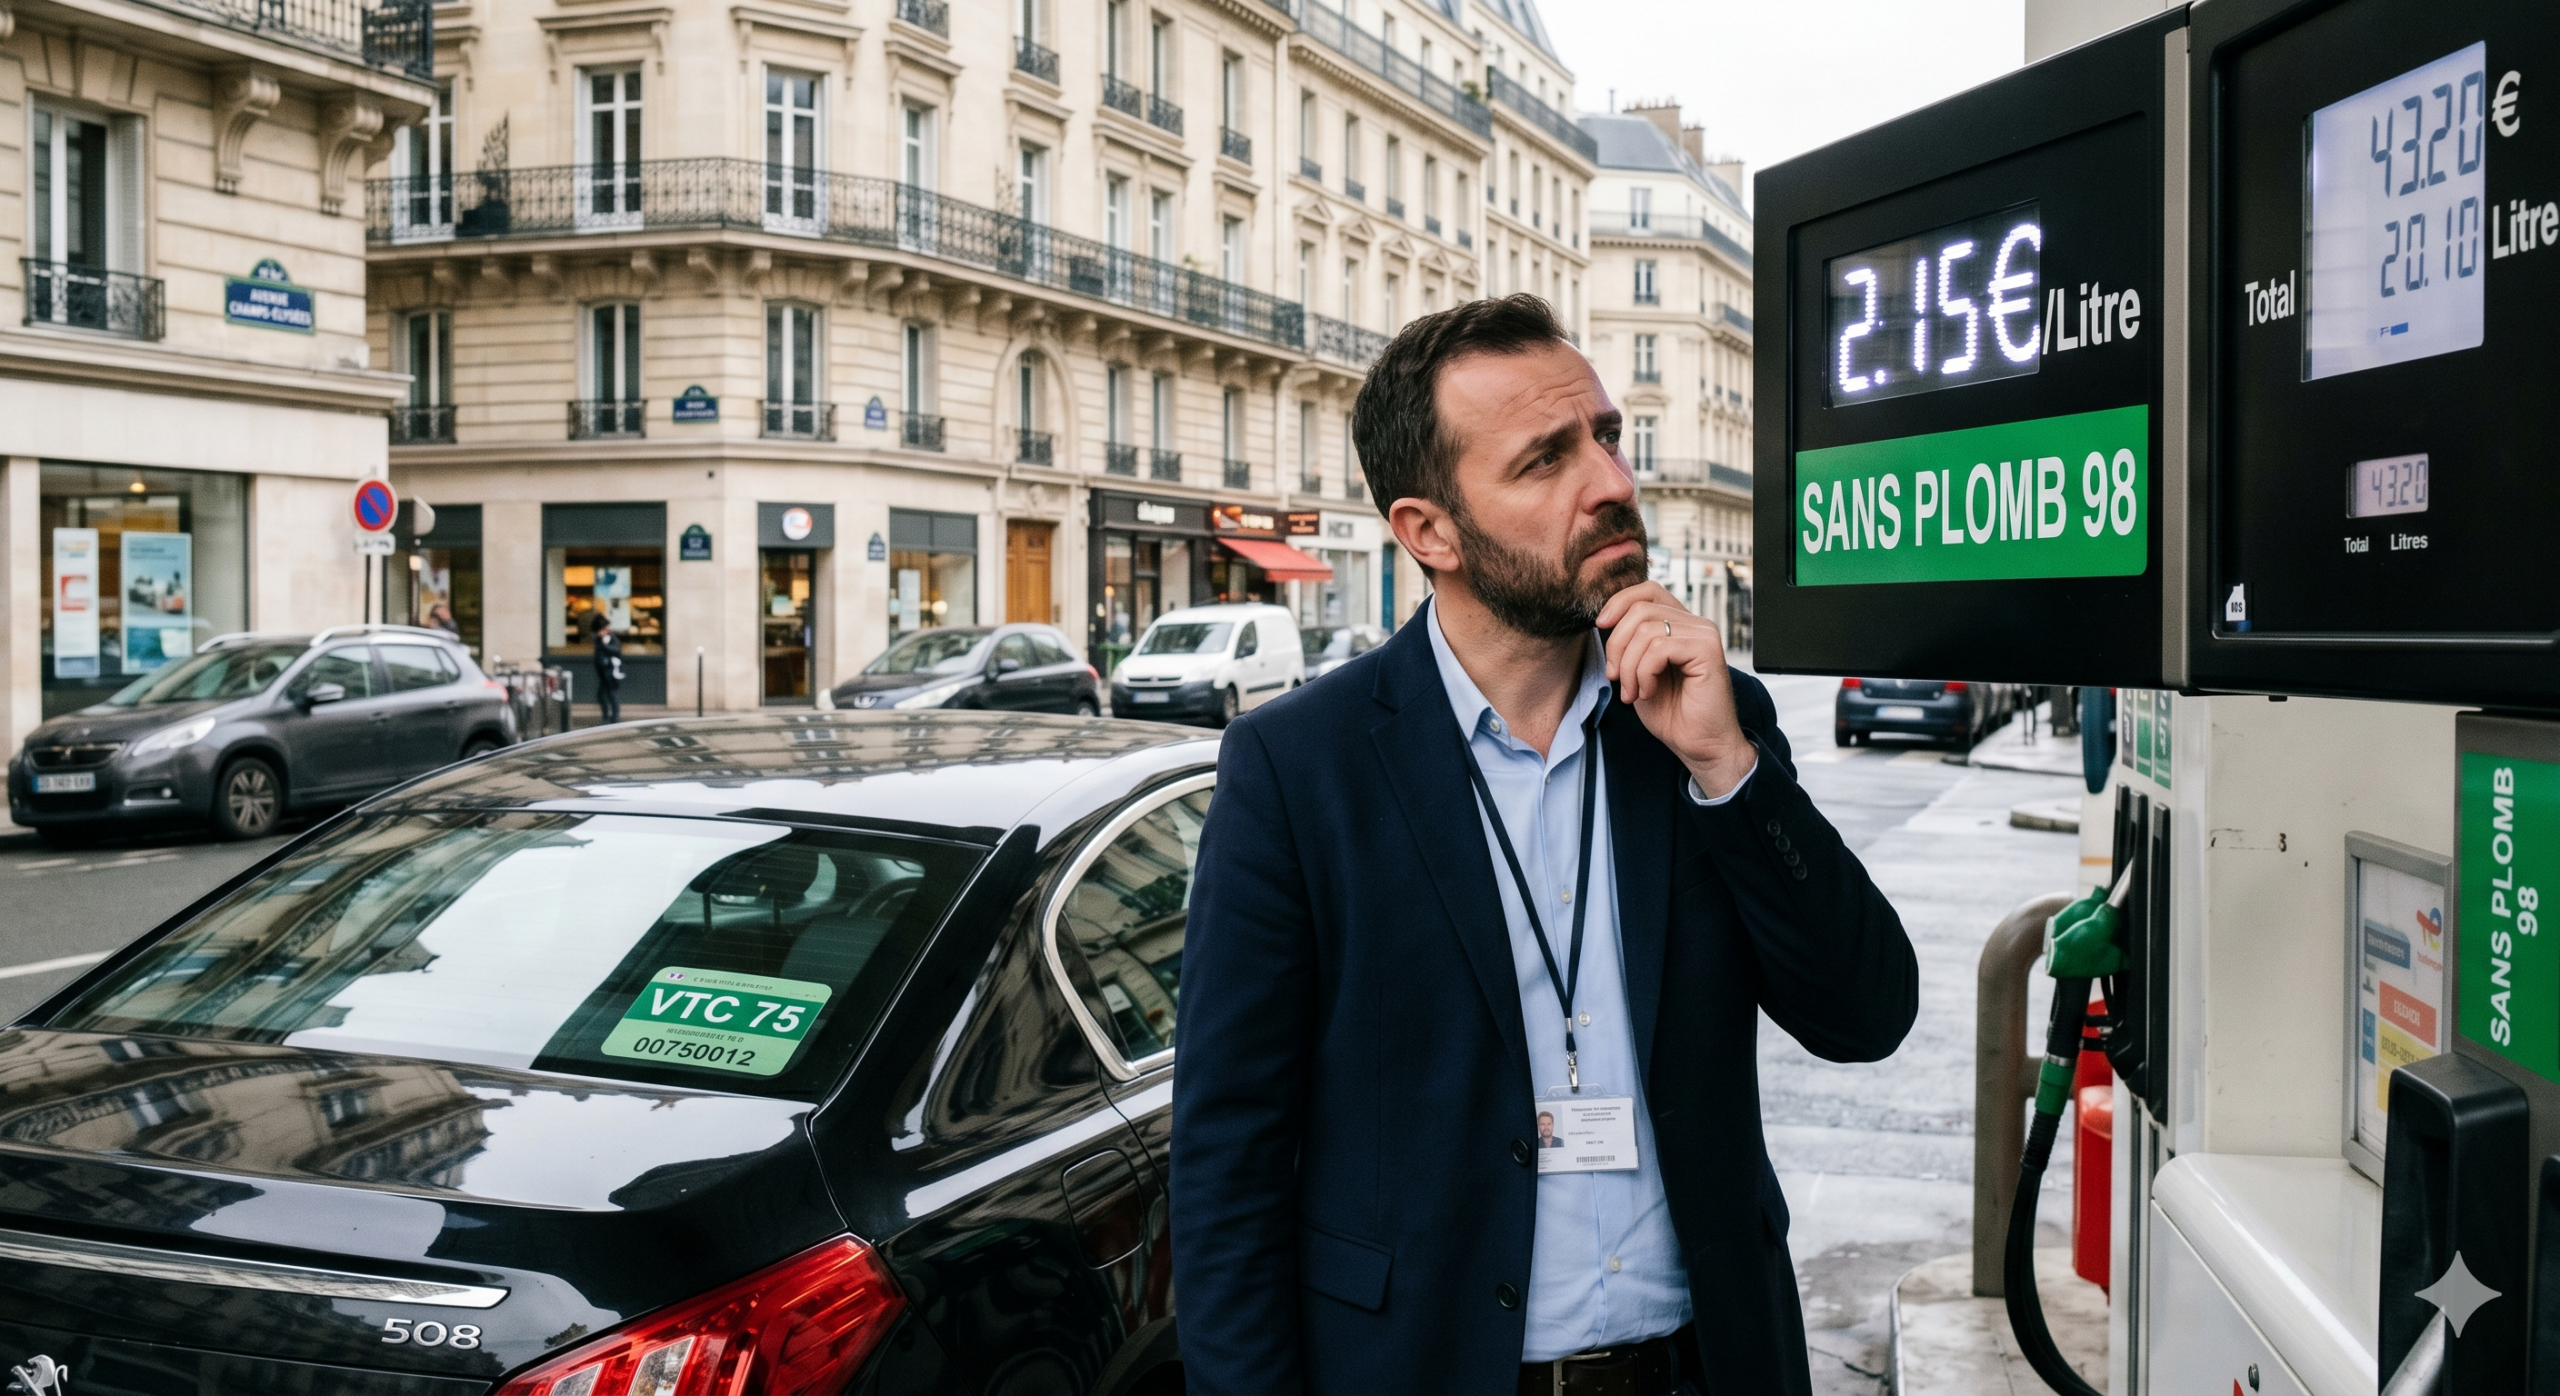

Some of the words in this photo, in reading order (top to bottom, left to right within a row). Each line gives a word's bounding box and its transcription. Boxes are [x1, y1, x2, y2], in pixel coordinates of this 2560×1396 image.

[2371, 70, 2484, 198] 43.20
[2491, 70, 2522, 137] €
[2380, 196, 2479, 298] 20.10
[2492, 199, 2559, 260] Litre
[2042, 281, 2141, 355] /Litre
[2244, 269, 2295, 327] Total
[1802, 472, 1901, 554] SANS
[1915, 456, 2067, 547] PLOMB
[2082, 448, 2137, 538] 98
[2344, 536, 2369, 554] Total
[2390, 533, 2428, 551] Litres
[2491, 767, 2514, 918] PLOMB
[2516, 886, 2538, 937] 98
[651, 988, 740, 1024] VTC
[748, 1001, 806, 1033] 75
[2490, 930, 2512, 1047] SANS
[633, 1037, 756, 1067] 00750012
[381, 1318, 481, 1349] 508
